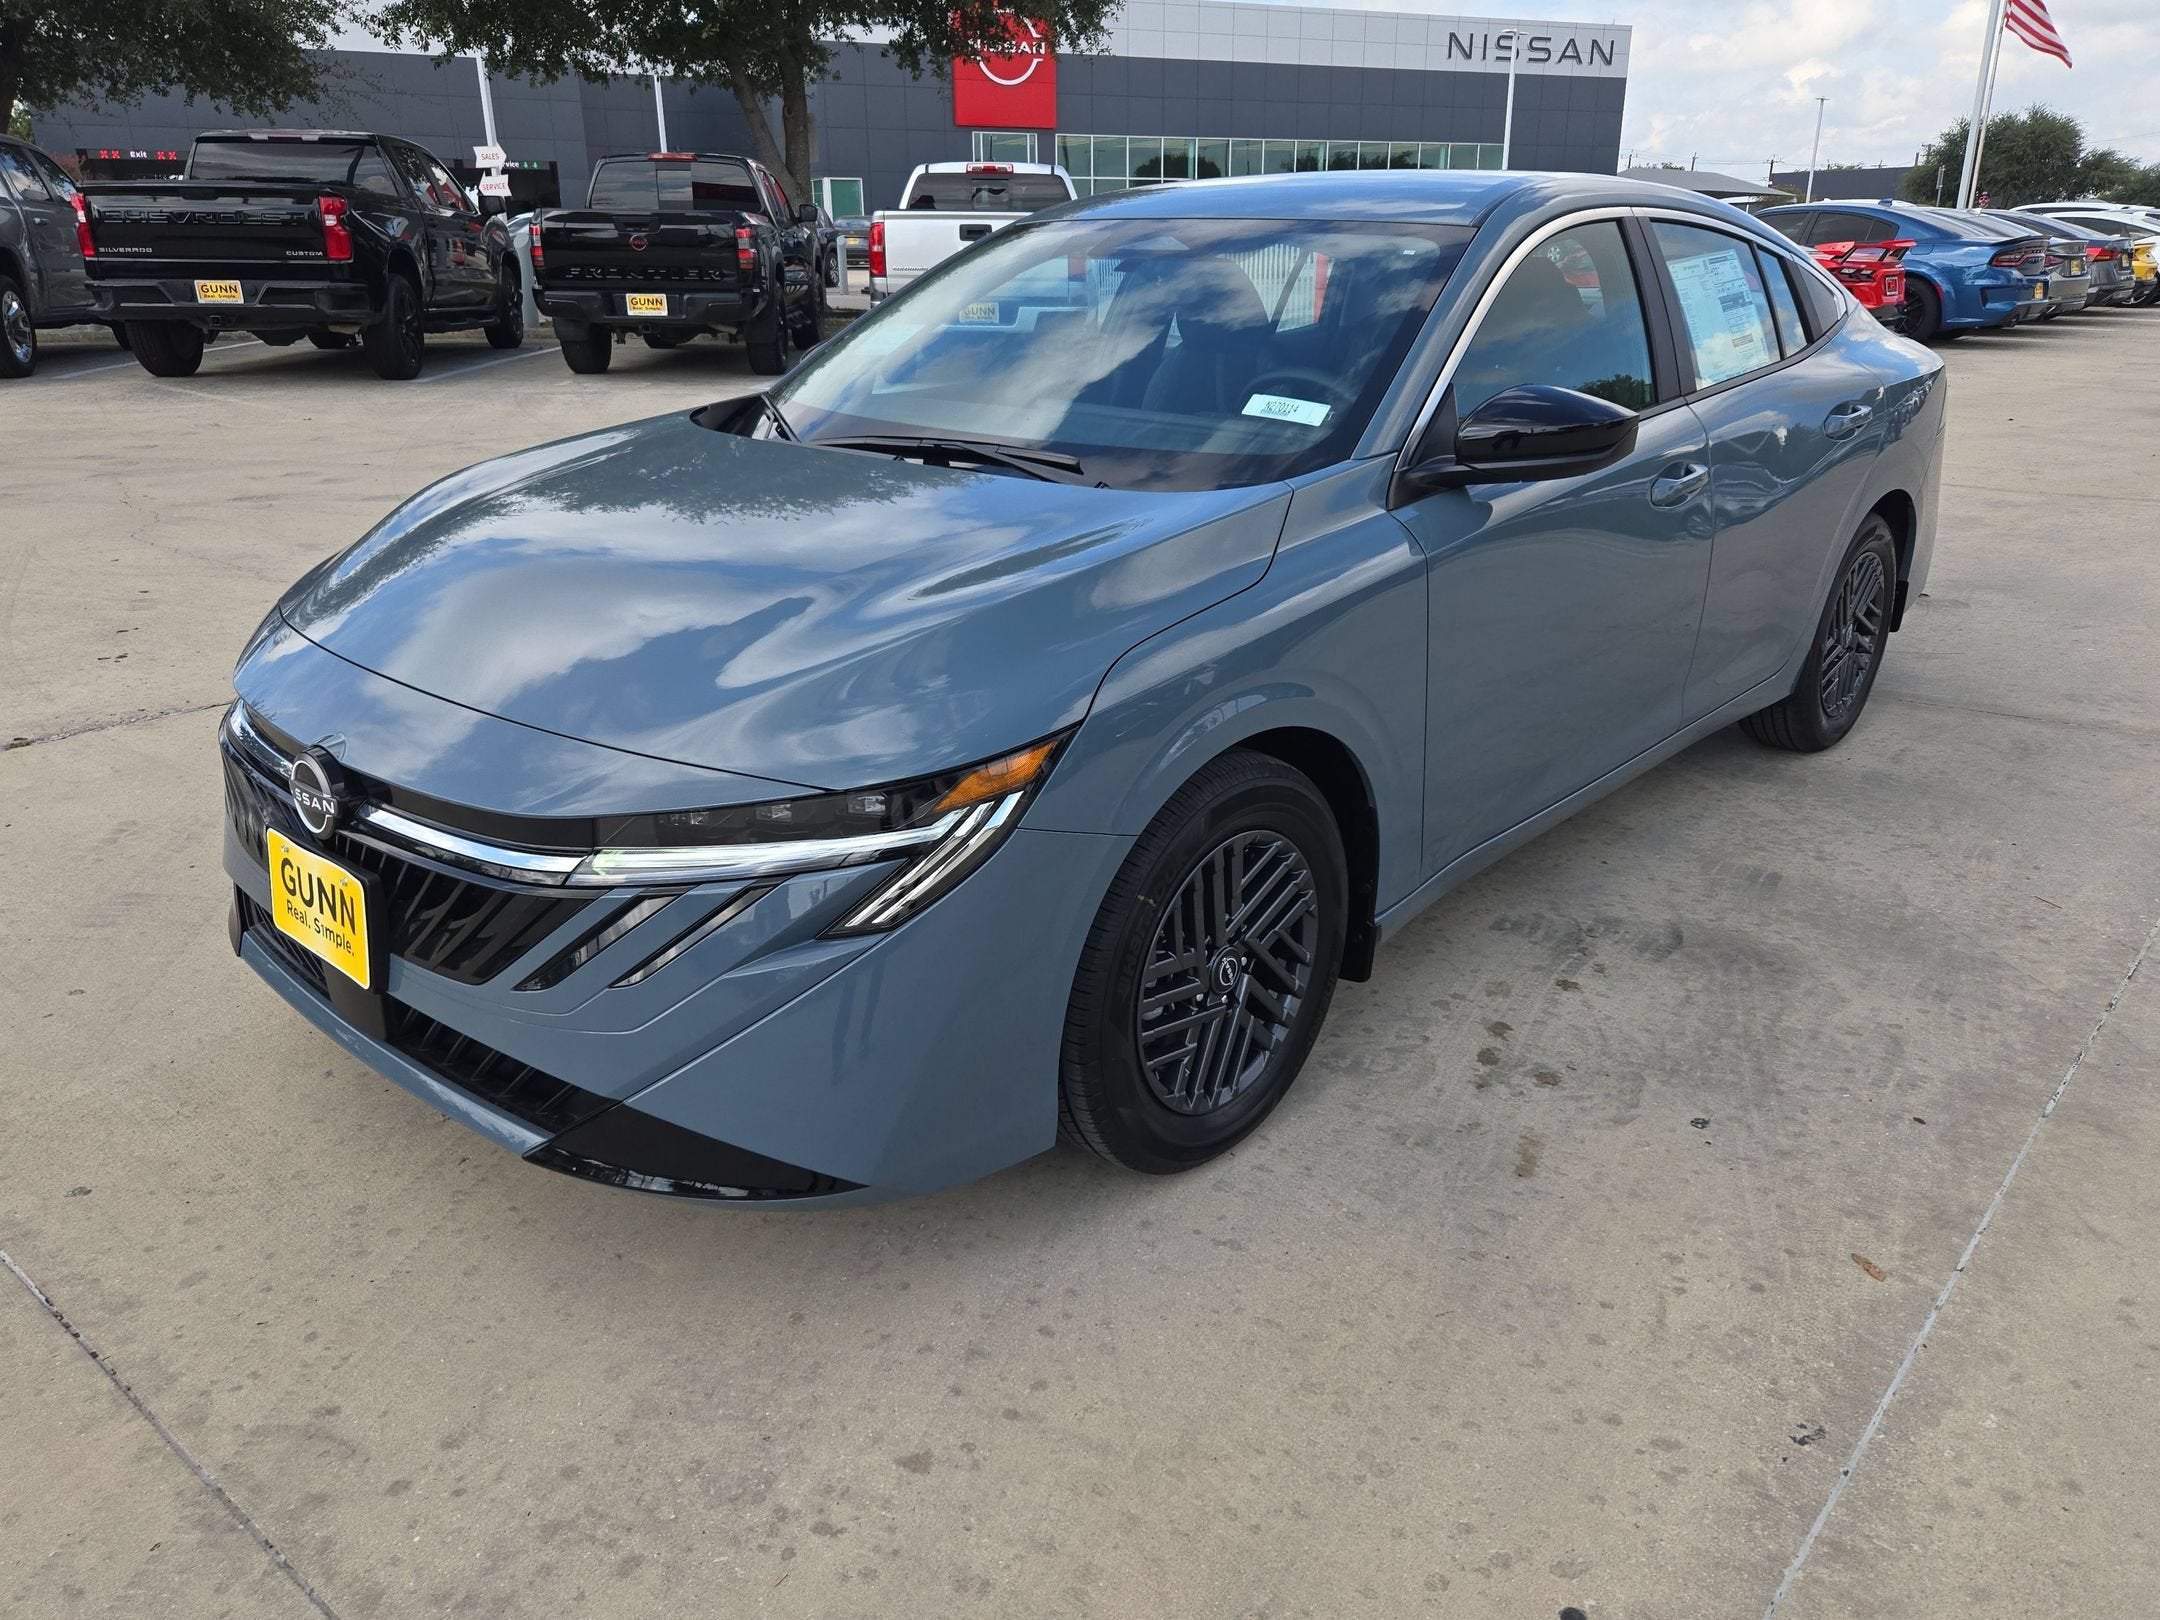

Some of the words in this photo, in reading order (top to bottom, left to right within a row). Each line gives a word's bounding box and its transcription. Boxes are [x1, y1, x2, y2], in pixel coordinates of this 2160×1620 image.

[1448, 32, 1614, 65] NISSAN
[482, 182, 506, 191] SERVICE
[104, 210, 305, 225] CHEVROLET
[201, 284, 238, 293] GUNN
[631, 297, 663, 306] GUNN
[281, 857, 356, 936] GUNN
[287, 899, 311, 929] Real.
